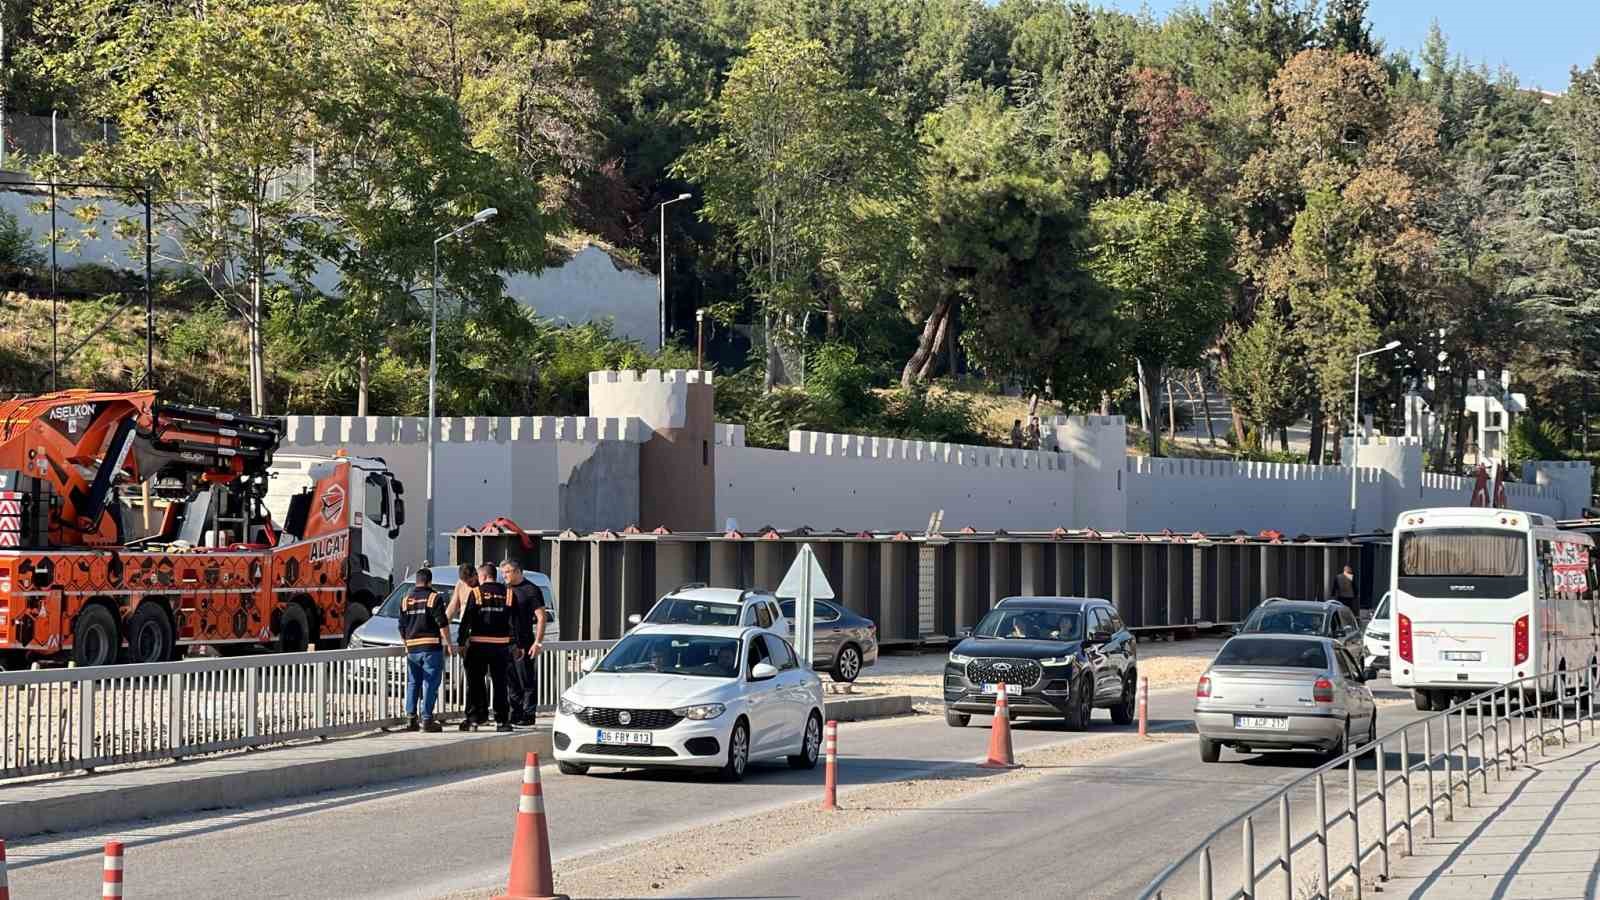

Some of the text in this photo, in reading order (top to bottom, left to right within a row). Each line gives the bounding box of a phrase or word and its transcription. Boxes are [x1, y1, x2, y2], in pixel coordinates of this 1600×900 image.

[49, 403, 95, 420] ASELKON
[601, 731, 611, 741] 06
[615, 731, 630, 742] FBY
